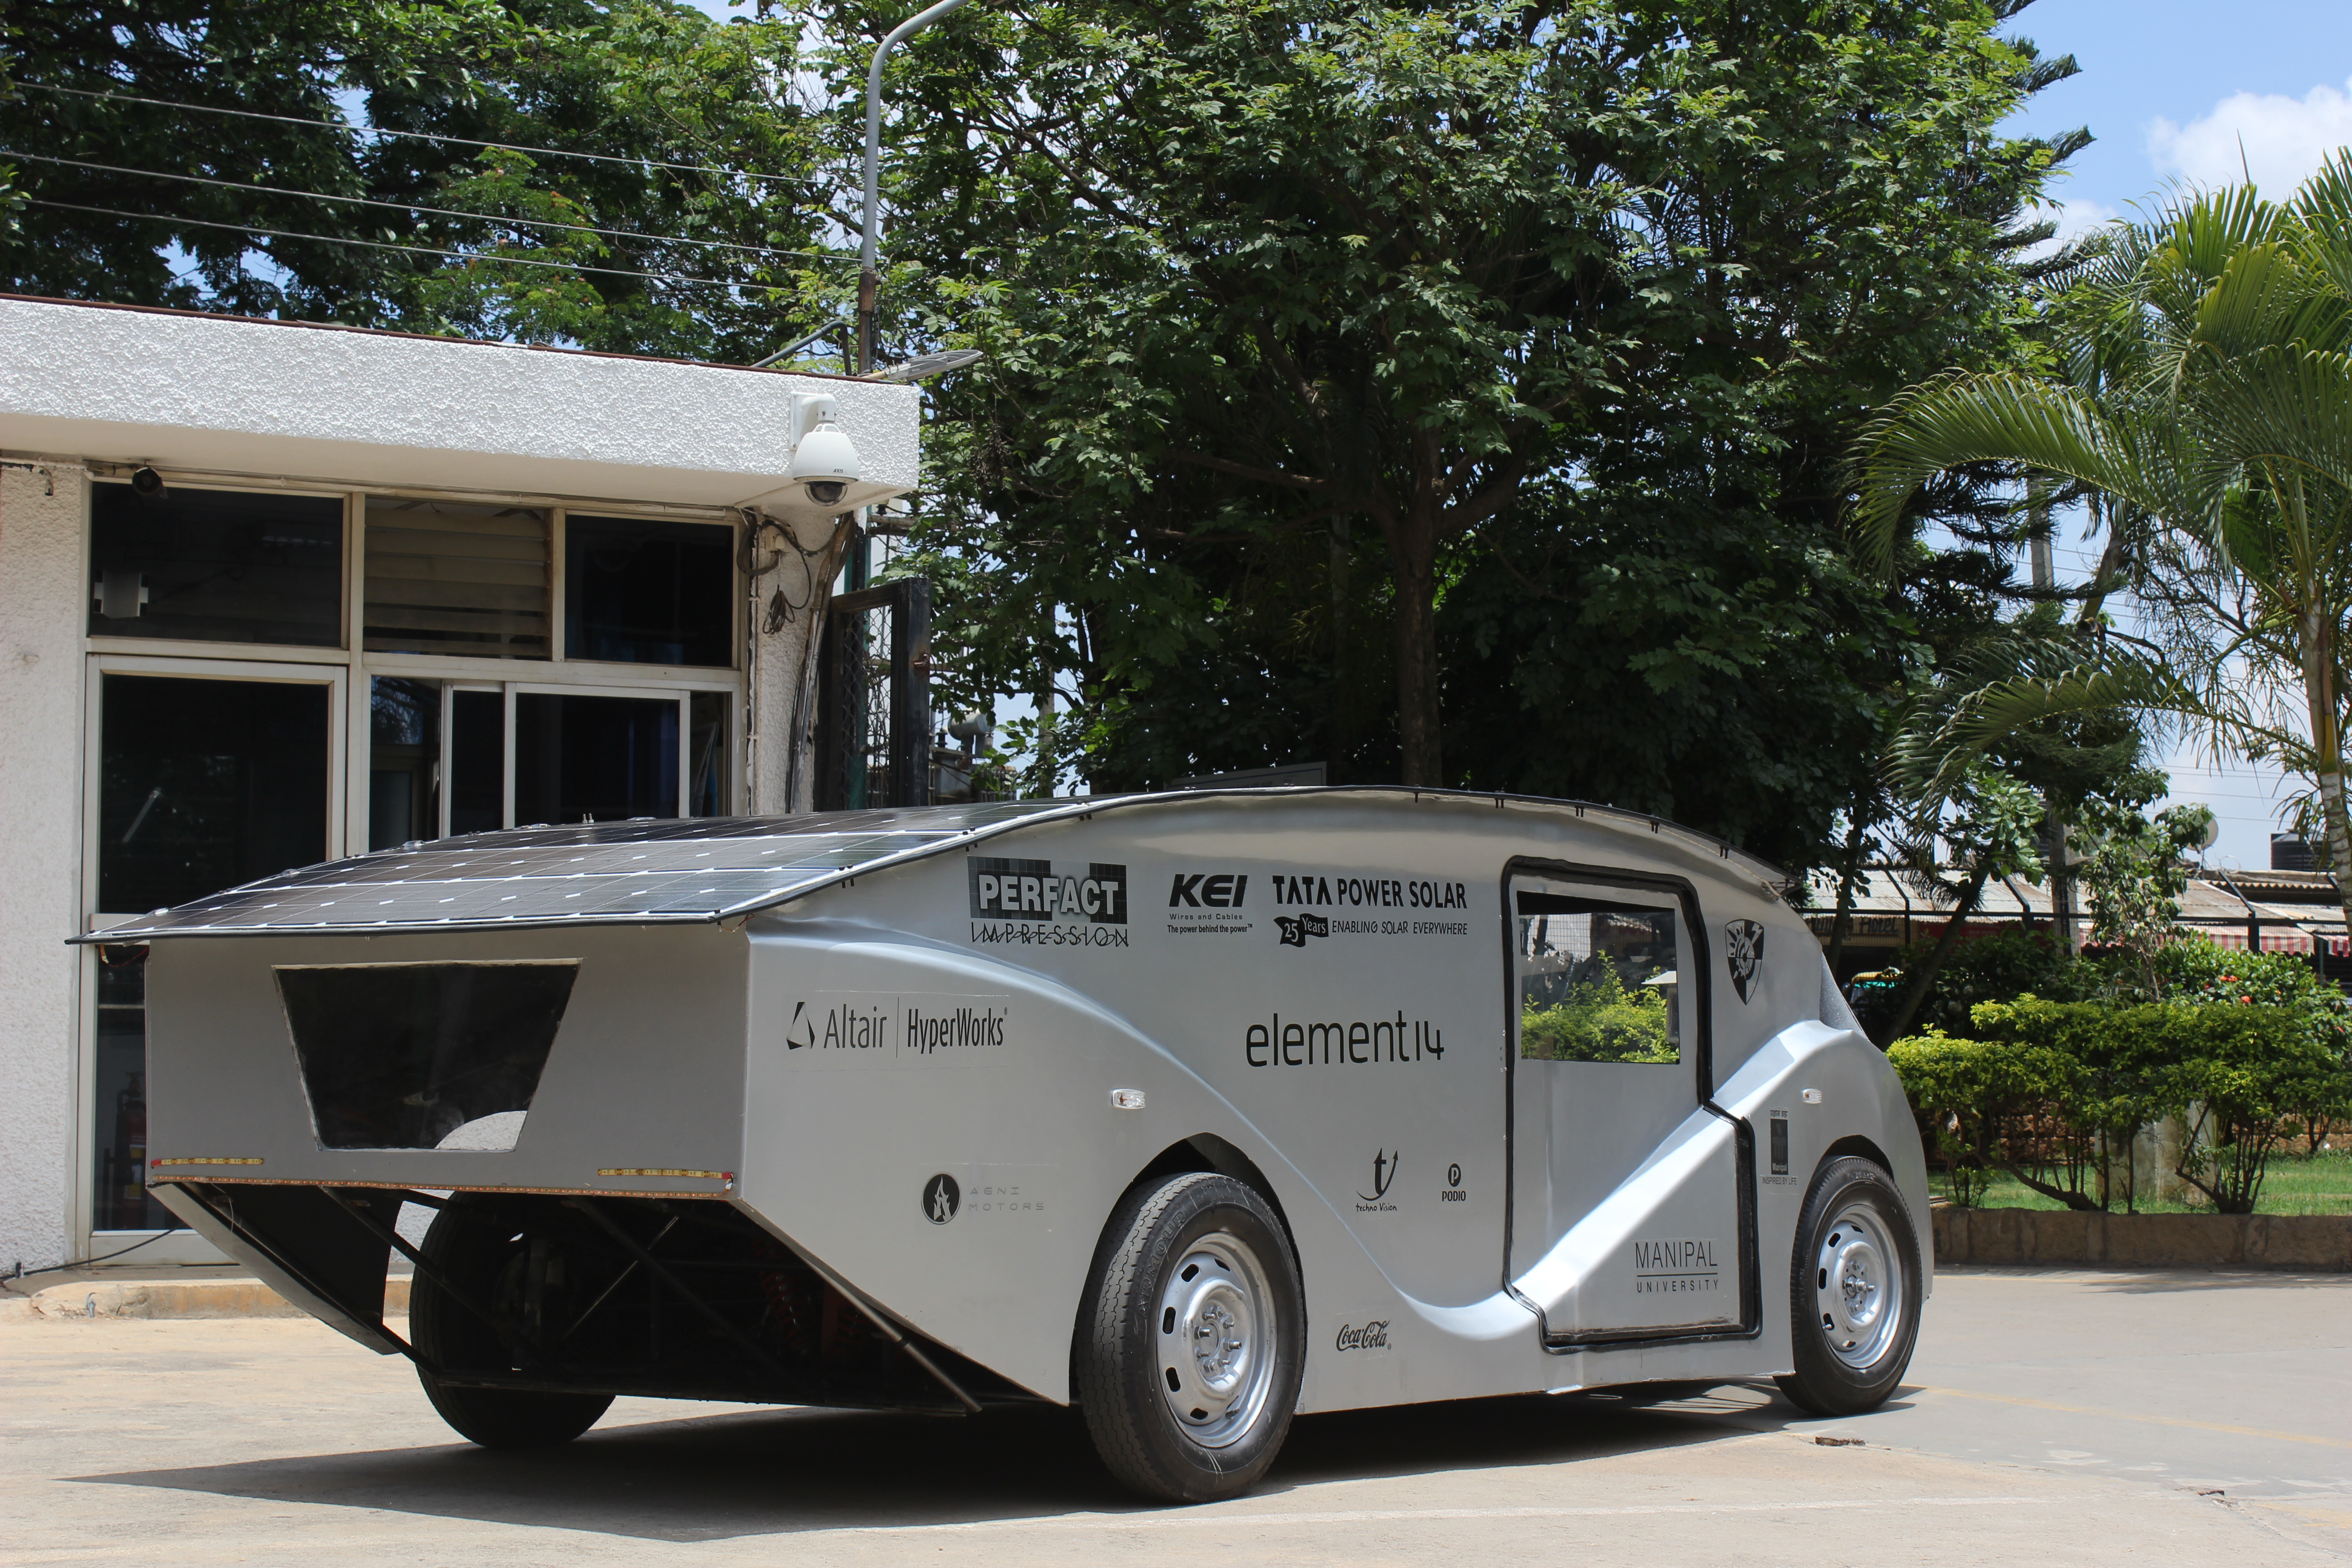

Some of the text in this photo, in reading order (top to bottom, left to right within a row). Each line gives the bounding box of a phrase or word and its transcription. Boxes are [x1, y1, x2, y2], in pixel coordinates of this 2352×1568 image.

[979, 874, 1118, 915] PERFACT
[1169, 873, 1248, 907] KEI
[1272, 875, 1468, 909] TATA POWER SOLAR
[971, 921, 1129, 947] IMPRESSION
[1167, 925, 1178, 933] The
[1180, 926, 1198, 935] power
[1199, 925, 1218, 933] behind
[1220, 925, 1229, 933] the
[1284, 917, 1326, 942] 25 Years
[1332, 921, 1468, 935] ENABLING SOLAR EVERYWHERE
[823, 1004, 887, 1049] Altair
[1246, 1010, 1445, 1067] element14
[1772, 1163, 1788, 1173] Manipal
[970, 1187, 1019, 1195] AGNI
[1441, 1191, 1466, 1202] PODIO
[969, 1203, 1044, 1211] MOTORS
[1355, 1203, 1397, 1212] techno Vision
[1635, 1241, 1717, 1269] MANIPAL
[1637, 1279, 1718, 1293] UNIVERSITY
